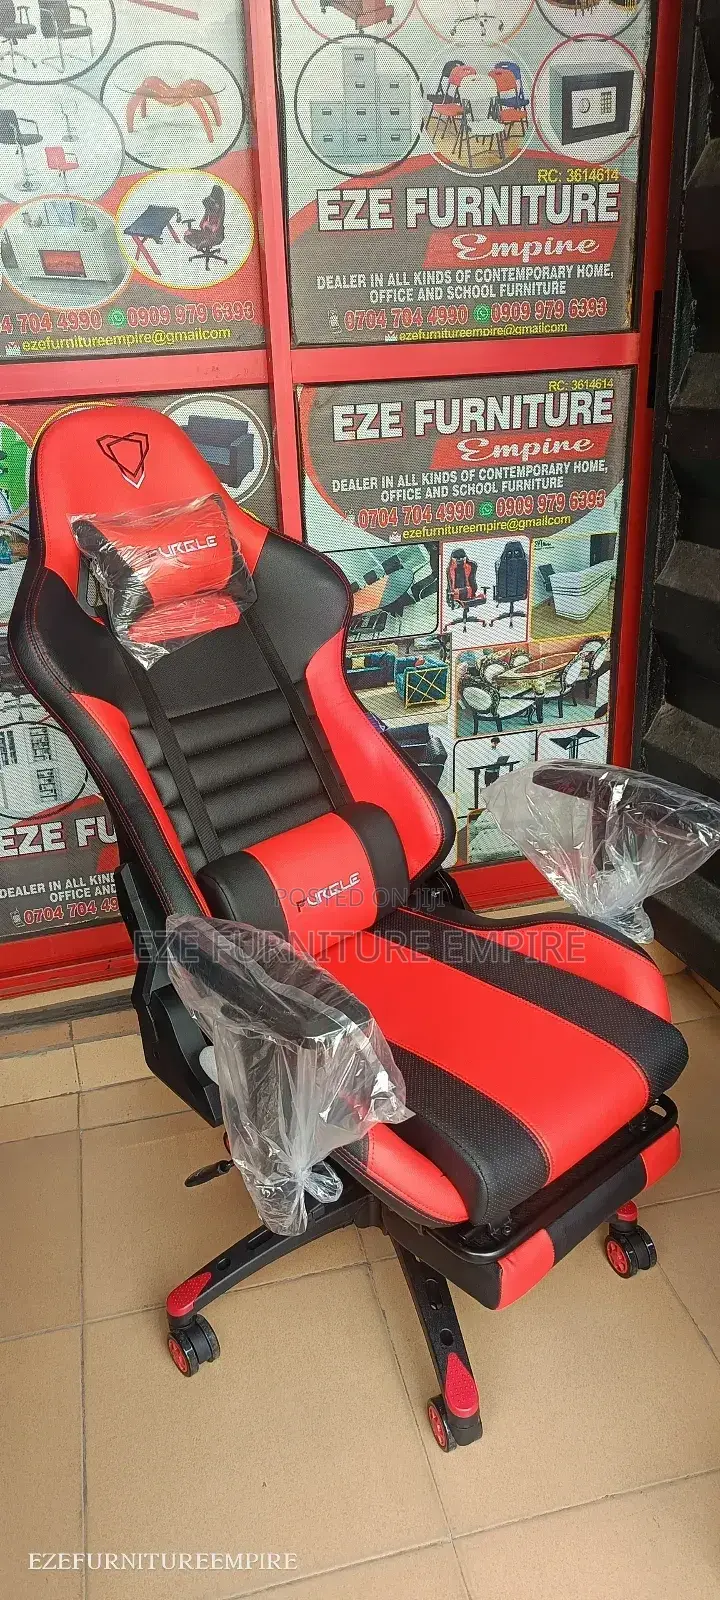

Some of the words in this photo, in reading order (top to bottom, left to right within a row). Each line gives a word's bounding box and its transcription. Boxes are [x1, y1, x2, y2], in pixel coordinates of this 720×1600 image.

[537, 168, 562, 183] RC:
[566, 168, 619, 182] 3614614
[317, 188, 394, 231] EZE
[406, 183, 620, 229] FURNITURE
[452, 233, 600, 262] Empire
[316, 273, 367, 290] DEALER
[370, 272, 383, 287] IN
[387, 271, 410, 286] ALL
[414, 270, 451, 285] KINDS
[455, 269, 472, 283] OF
[474, 265, 574, 282] CONTEMPORARY
[577, 263, 614, 279] HOME,
[369, 289, 414, 304] OFFICE
[417, 286, 443, 301] AND
[447, 284, 497, 300] SCHOOL
[500, 281, 567, 298] FURNITURE
[16, 312, 53, 334] 704
[56, 309, 103, 331] 4990
[127, 305, 171, 328] 0909
[175, 302, 208, 324] 979
[212, 301, 255, 323] 6393
[344, 309, 387, 331] 0704
[390, 306, 424, 328] 704
[427, 304, 469, 326] 4990
[491, 301, 531, 323] 0909
[535, 299, 565, 320] 979
[569, 297, 608, 318] 6393
[548, 379, 569, 392] RC:
[571, 378, 614, 391] 3614614
[332, 402, 403, 442] EZE
[414, 390, 614, 437] FURNITURE
[456, 435, 595, 462] Empire
[331, 477, 378, 493] DEALER
[381, 475, 394, 489] IN
[397, 473, 418, 488] ALL
[422, 470, 457, 485] KINDS
[460, 469, 475, 483] OF
[478, 461, 571, 480] CONTEMPORARY
[573, 459, 609, 474] HOME,
[380, 489, 421, 503] OFFICE
[425, 486, 449, 499] AND
[452, 483, 498, 497] SCHOOL
[501, 476, 564, 493] FURNITURE
[358, 506, 399, 529] 0704
[402, 504, 432, 526] 704
[436, 500, 475, 522] 4990
[496, 495, 534, 518] 0909
[537, 492, 566, 514] 979
[569, 489, 606, 511] 6393
[0, 821, 66, 858] EZE
[0, 882, 46, 899] DEALER
[49, 880, 60, 892] IN
[65, 877, 86, 889] ALL
[49, 888, 91, 903] OFFICE
[94, 883, 117, 897] AND
[24, 905, 64, 924] 0704
[67, 900, 97, 918] 704
